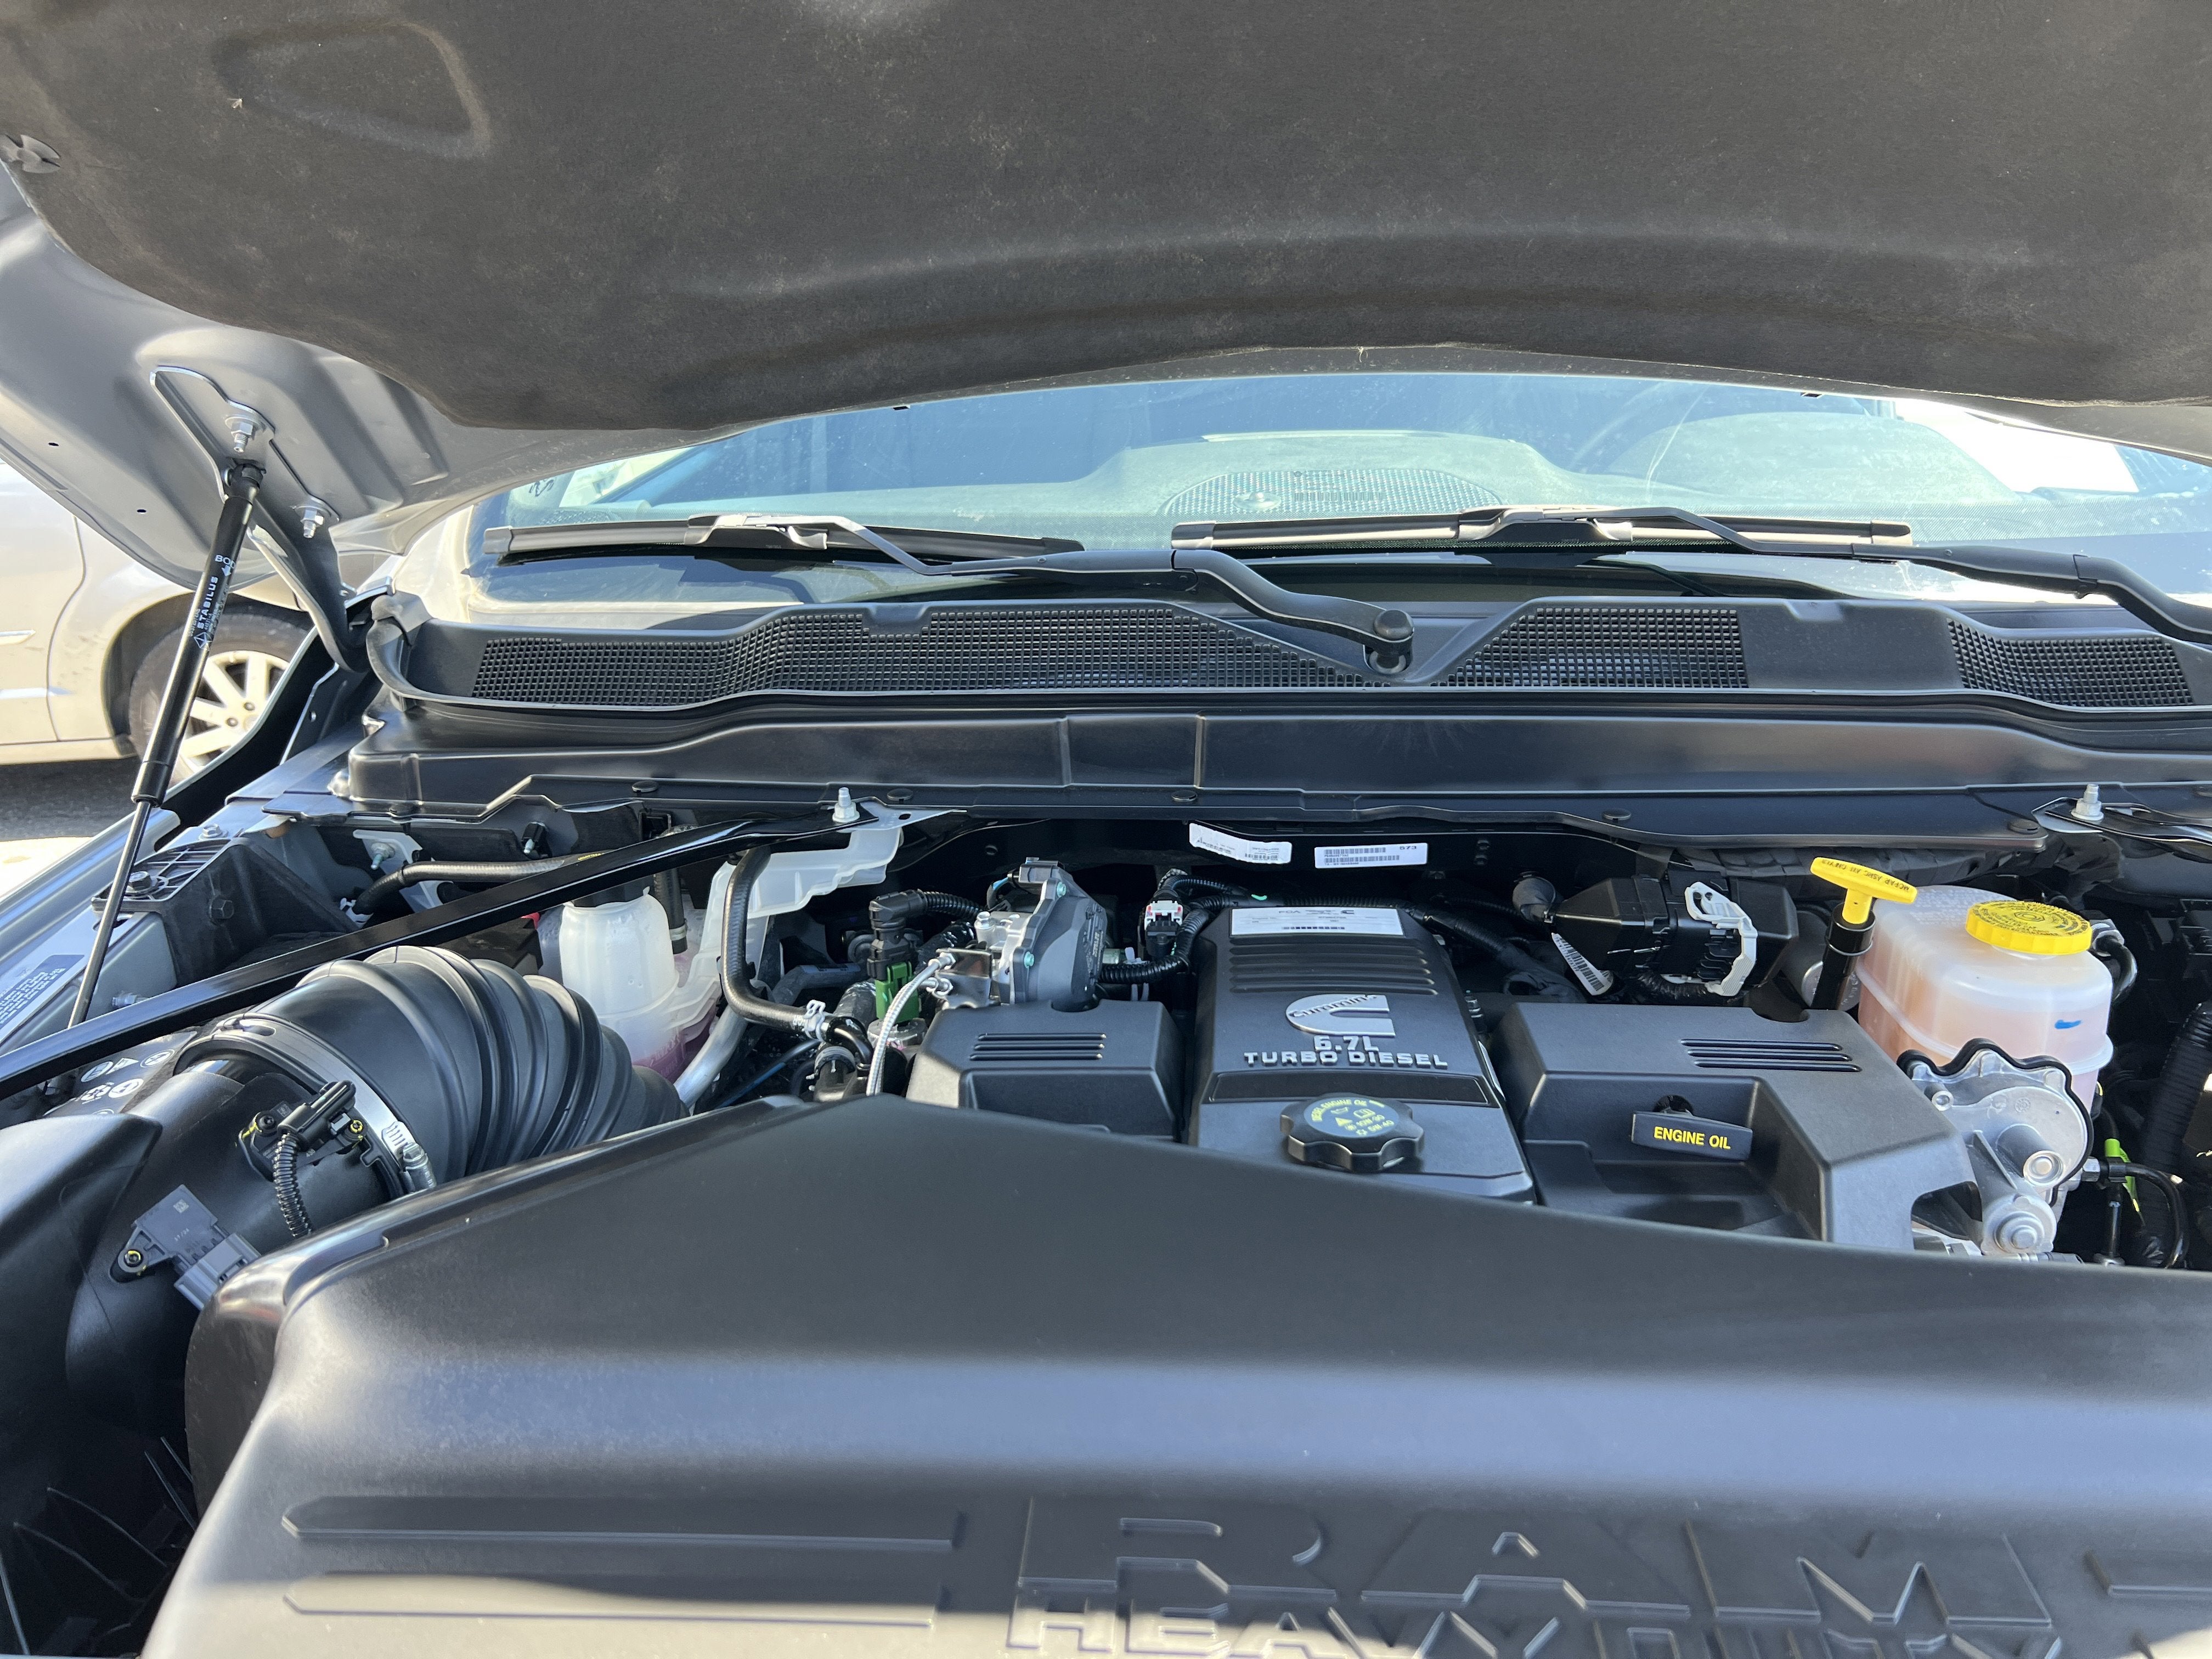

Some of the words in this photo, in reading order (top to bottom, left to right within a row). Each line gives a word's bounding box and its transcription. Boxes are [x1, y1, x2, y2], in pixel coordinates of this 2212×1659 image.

[215, 554, 235, 569] BOD
[197, 576, 218, 629] STABILUS
[1289, 995, 1378, 1018] Cummins
[1314, 1035, 1379, 1052] 6.7L
[1244, 1050, 1338, 1066] TURBO
[1348, 1050, 1448, 1069] DIESEL
[1654, 1126, 1705, 1146] ENGINE
[1709, 1135, 1731, 1149] OIL
[1018, 1496, 2053, 1627] RAM
[1006, 1594, 1561, 1659] HEAVY
